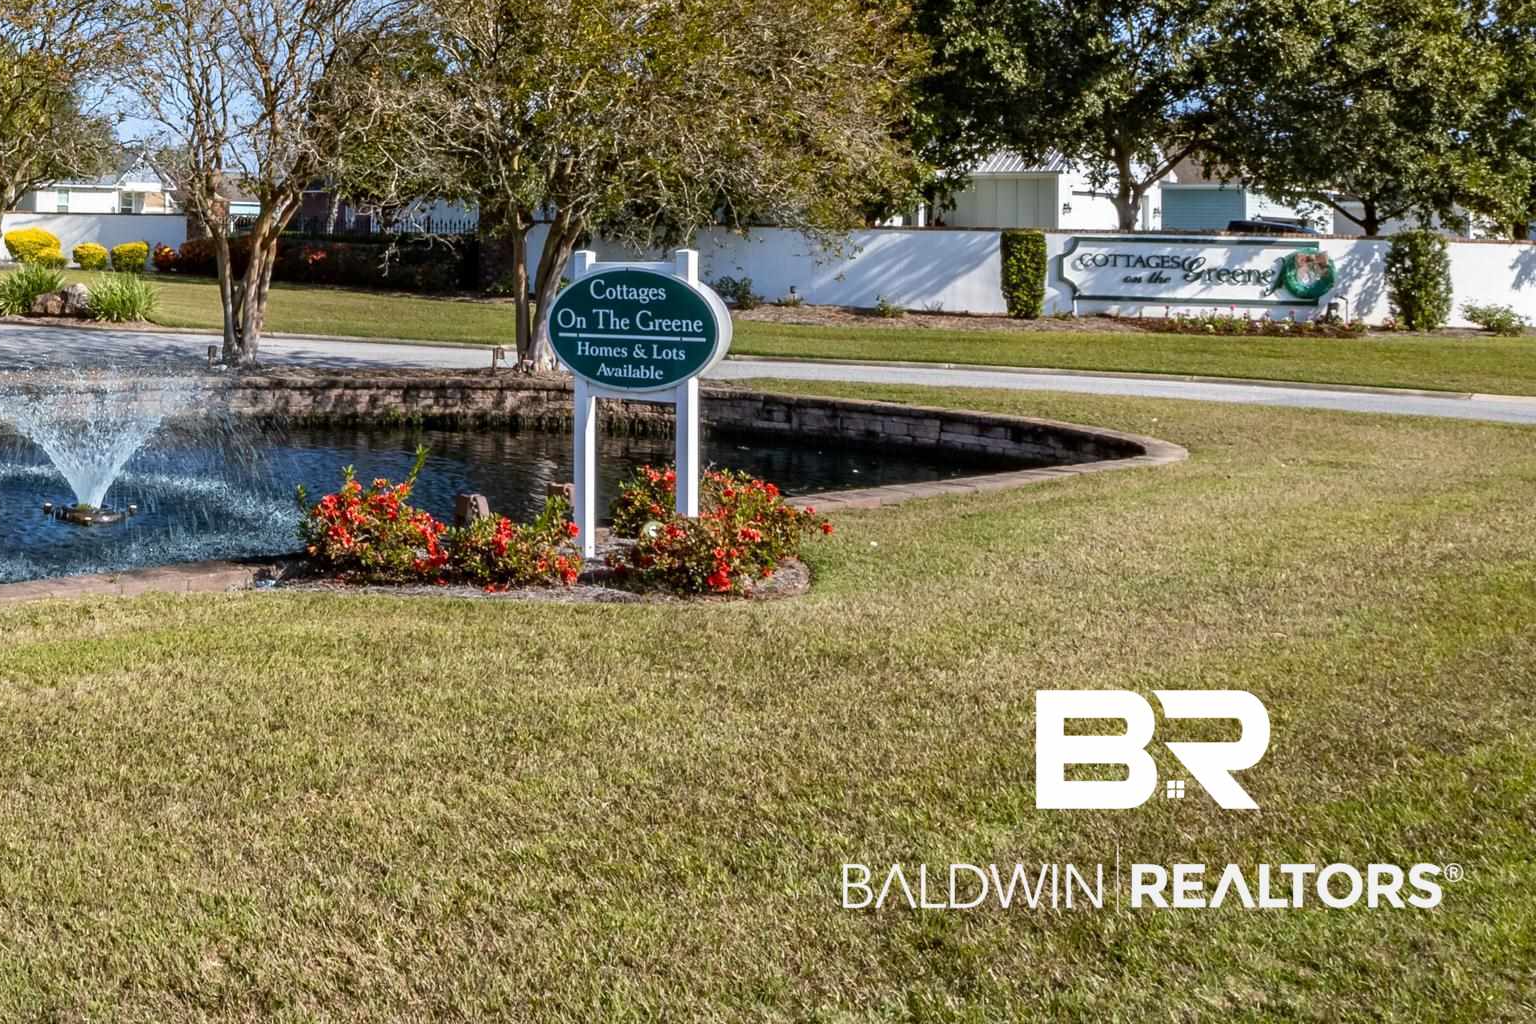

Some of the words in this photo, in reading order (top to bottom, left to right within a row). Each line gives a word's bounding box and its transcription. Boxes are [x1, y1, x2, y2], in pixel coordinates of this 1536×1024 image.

[1079, 253, 1181, 269] COTTAGES
[1122, 275, 1143, 284] on
[1146, 270, 1172, 284] the
[589, 279, 667, 304] Cottages
[557, 308, 587, 329] On
[592, 309, 630, 330] The
[635, 310, 704, 333] Greene
[576, 341, 628, 359] Homes
[632, 343, 649, 360] &
[652, 344, 686, 361] Lots
[596, 362, 664, 381] Available
